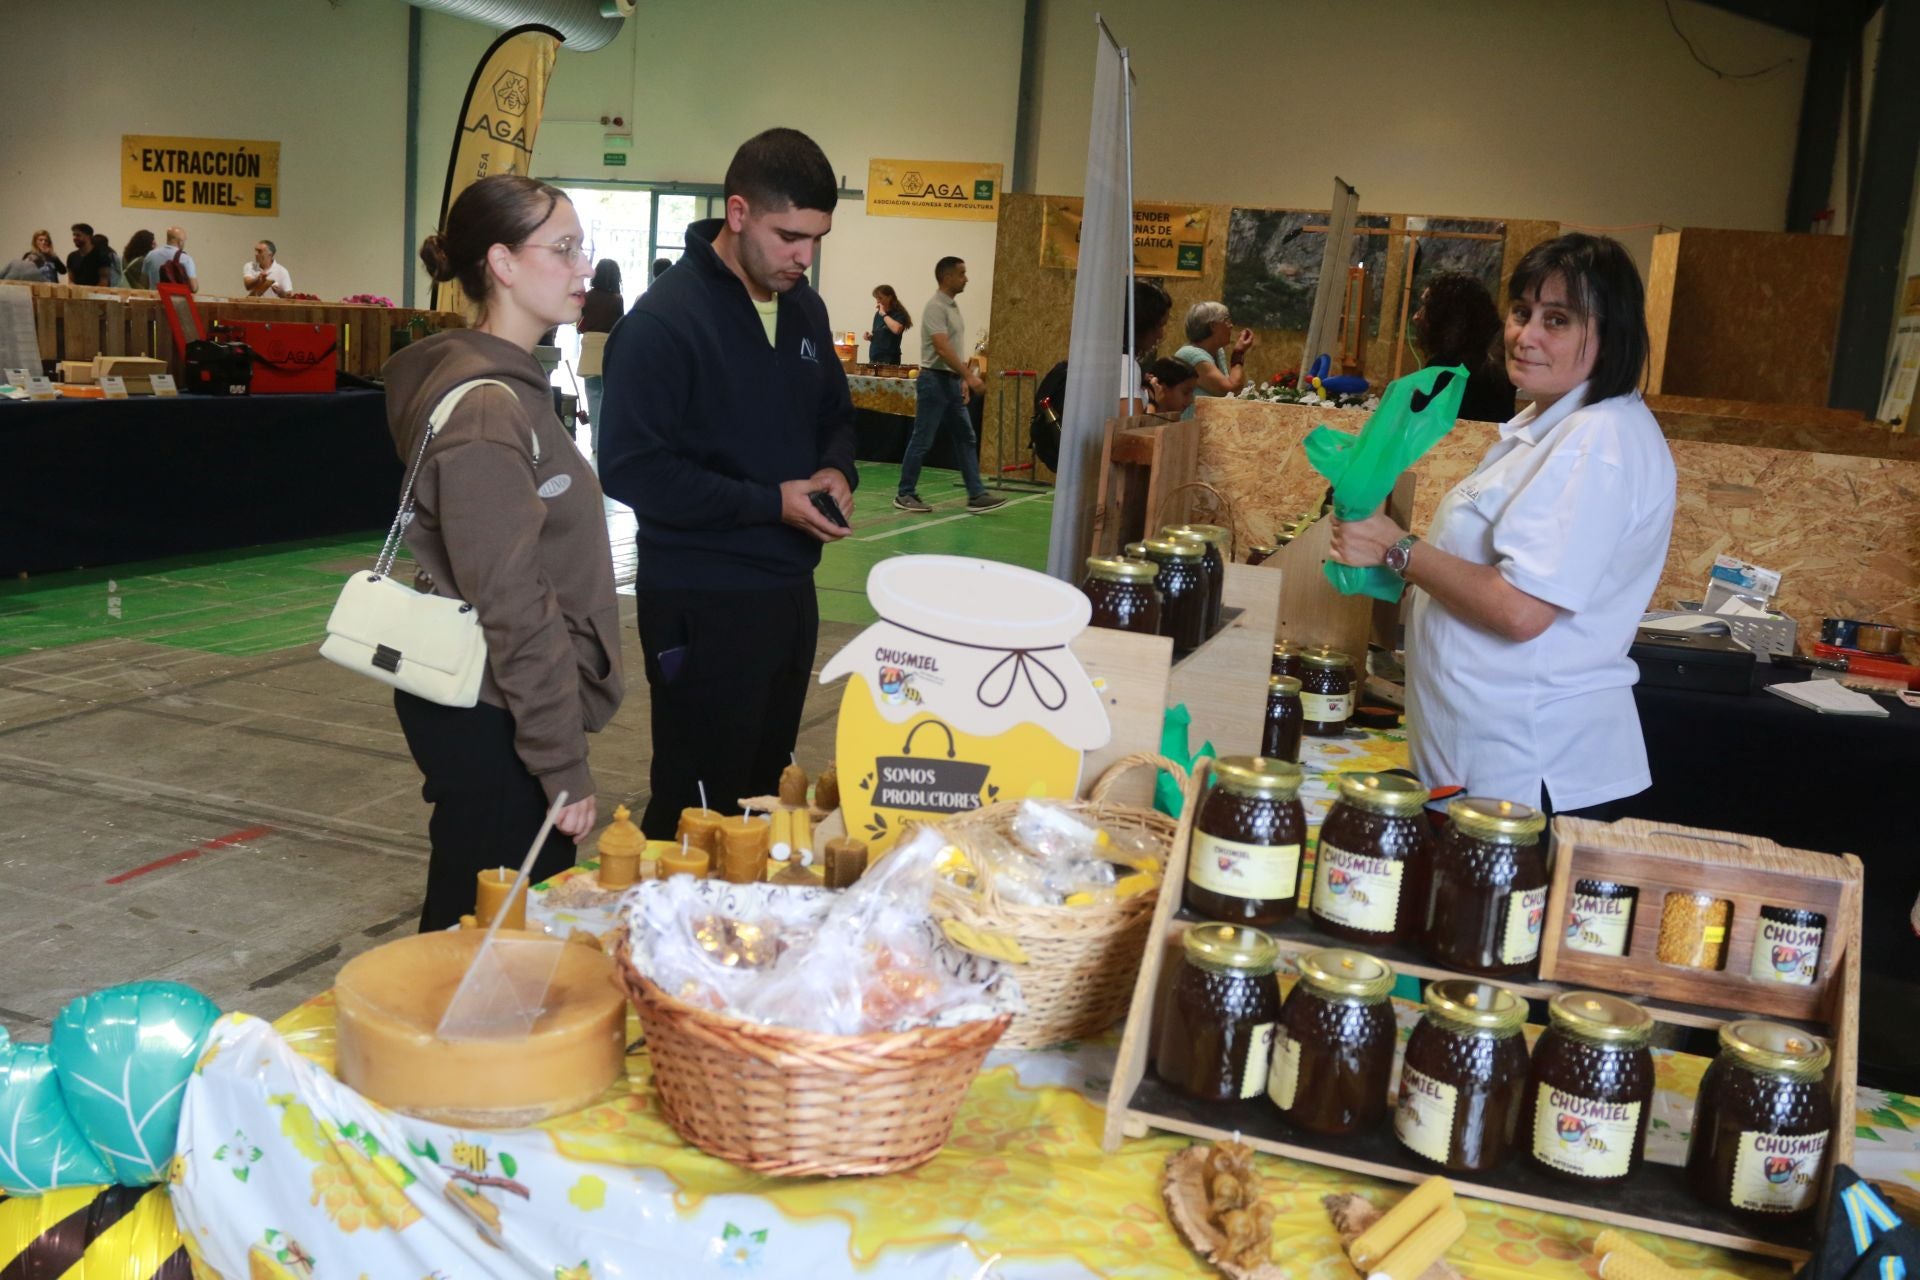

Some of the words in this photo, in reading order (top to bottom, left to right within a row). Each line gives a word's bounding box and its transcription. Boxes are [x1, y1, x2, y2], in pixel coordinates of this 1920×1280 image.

[468, 114, 531, 152] AGA
[142, 146, 260, 178] EXTRACCIÓN
[476, 152, 490, 179] ESA
[162, 179, 186, 203] DE
[192, 180, 237, 207] MIEL
[922, 183, 966, 199] AGA
[1132, 224, 1156, 235] NAS
[1158, 226, 1172, 236] DE
[875, 646, 939, 672] CHUSMIEL
[882, 767, 936, 785] SOMOS
[881, 788, 980, 809] PRODUCTORES
[1324, 847, 1391, 876] CHUSMIEL
[1550, 1091, 1630, 1121] CHUSMIEL
